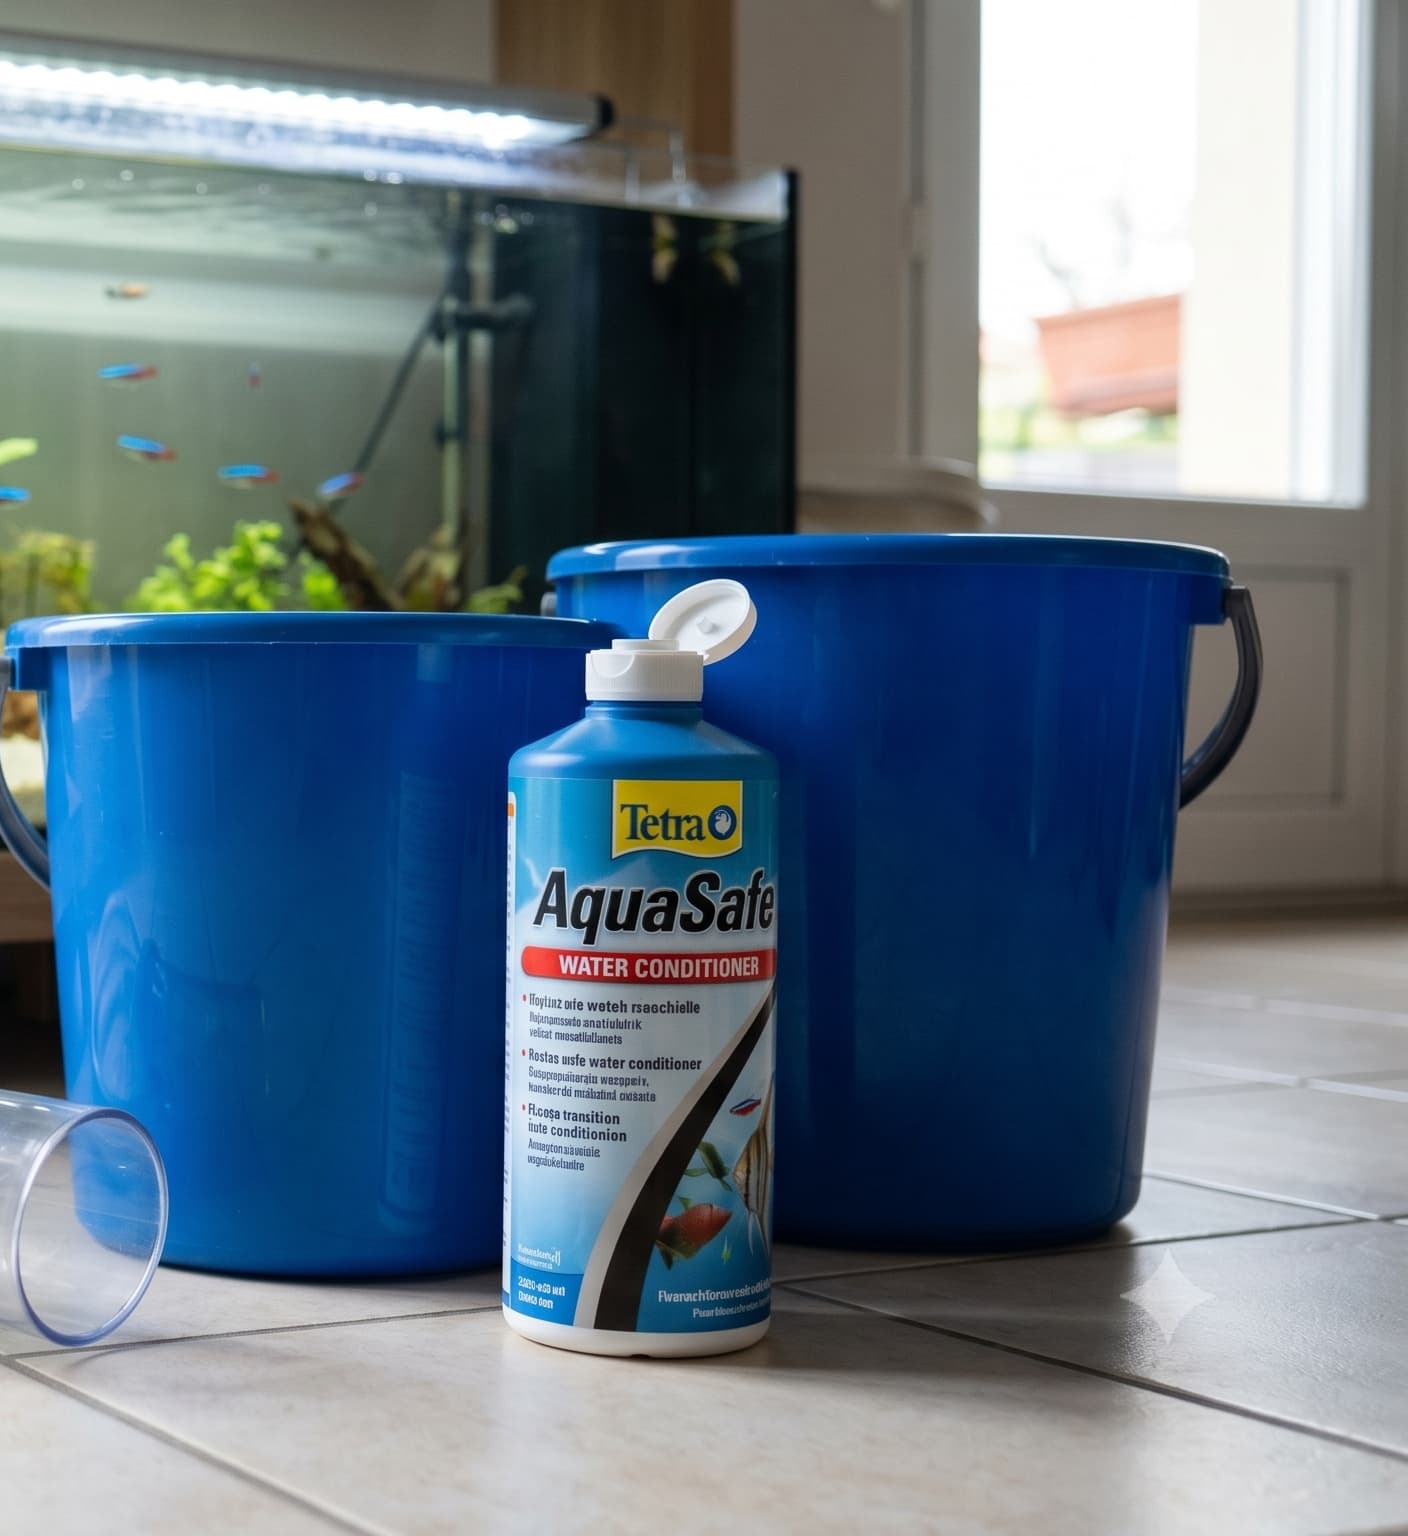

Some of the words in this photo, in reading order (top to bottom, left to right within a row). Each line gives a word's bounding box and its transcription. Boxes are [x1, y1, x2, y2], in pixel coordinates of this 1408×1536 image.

[620, 804, 706, 841] Tetra
[532, 868, 775, 946] AquaSafe
[559, 954, 629, 977] WATER
[635, 956, 760, 978] CONDITIONER
[589, 1056, 626, 1070] water
[628, 1057, 703, 1071] conditioner
[563, 1110, 621, 1125] transition
[550, 1126, 627, 1142] conditionion
